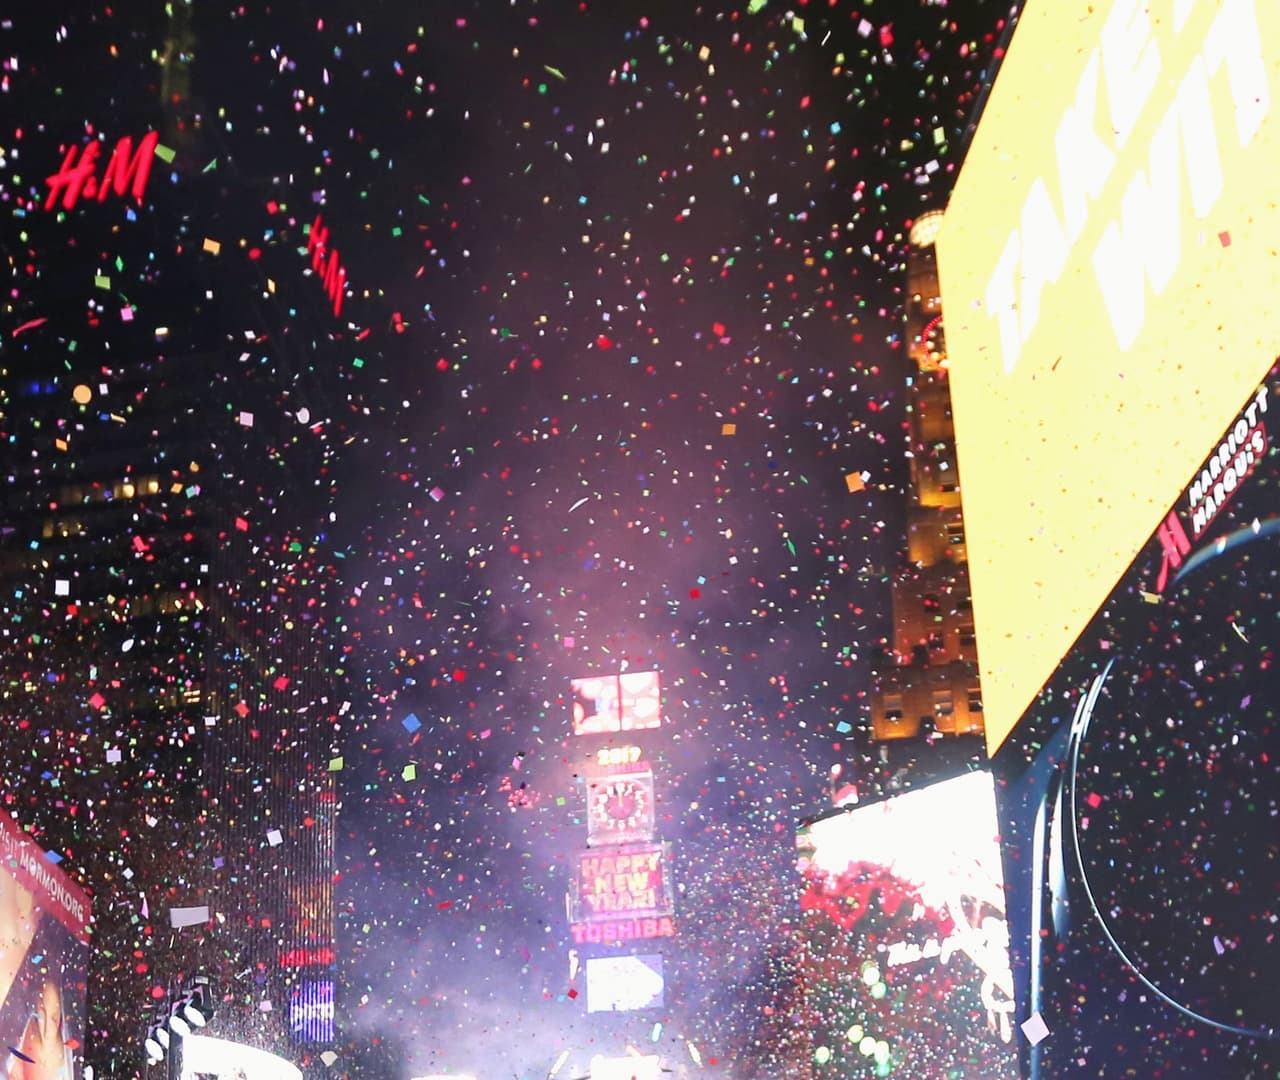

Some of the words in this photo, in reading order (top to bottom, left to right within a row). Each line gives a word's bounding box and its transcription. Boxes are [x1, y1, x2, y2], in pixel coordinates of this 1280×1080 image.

[44, 130, 158, 211] H&M
[1189, 386, 1269, 507] MARRIOTT
[581, 851, 662, 879] HAPPY
[593, 872, 650, 894] NEW
[571, 916, 676, 943] TOSHIBA
